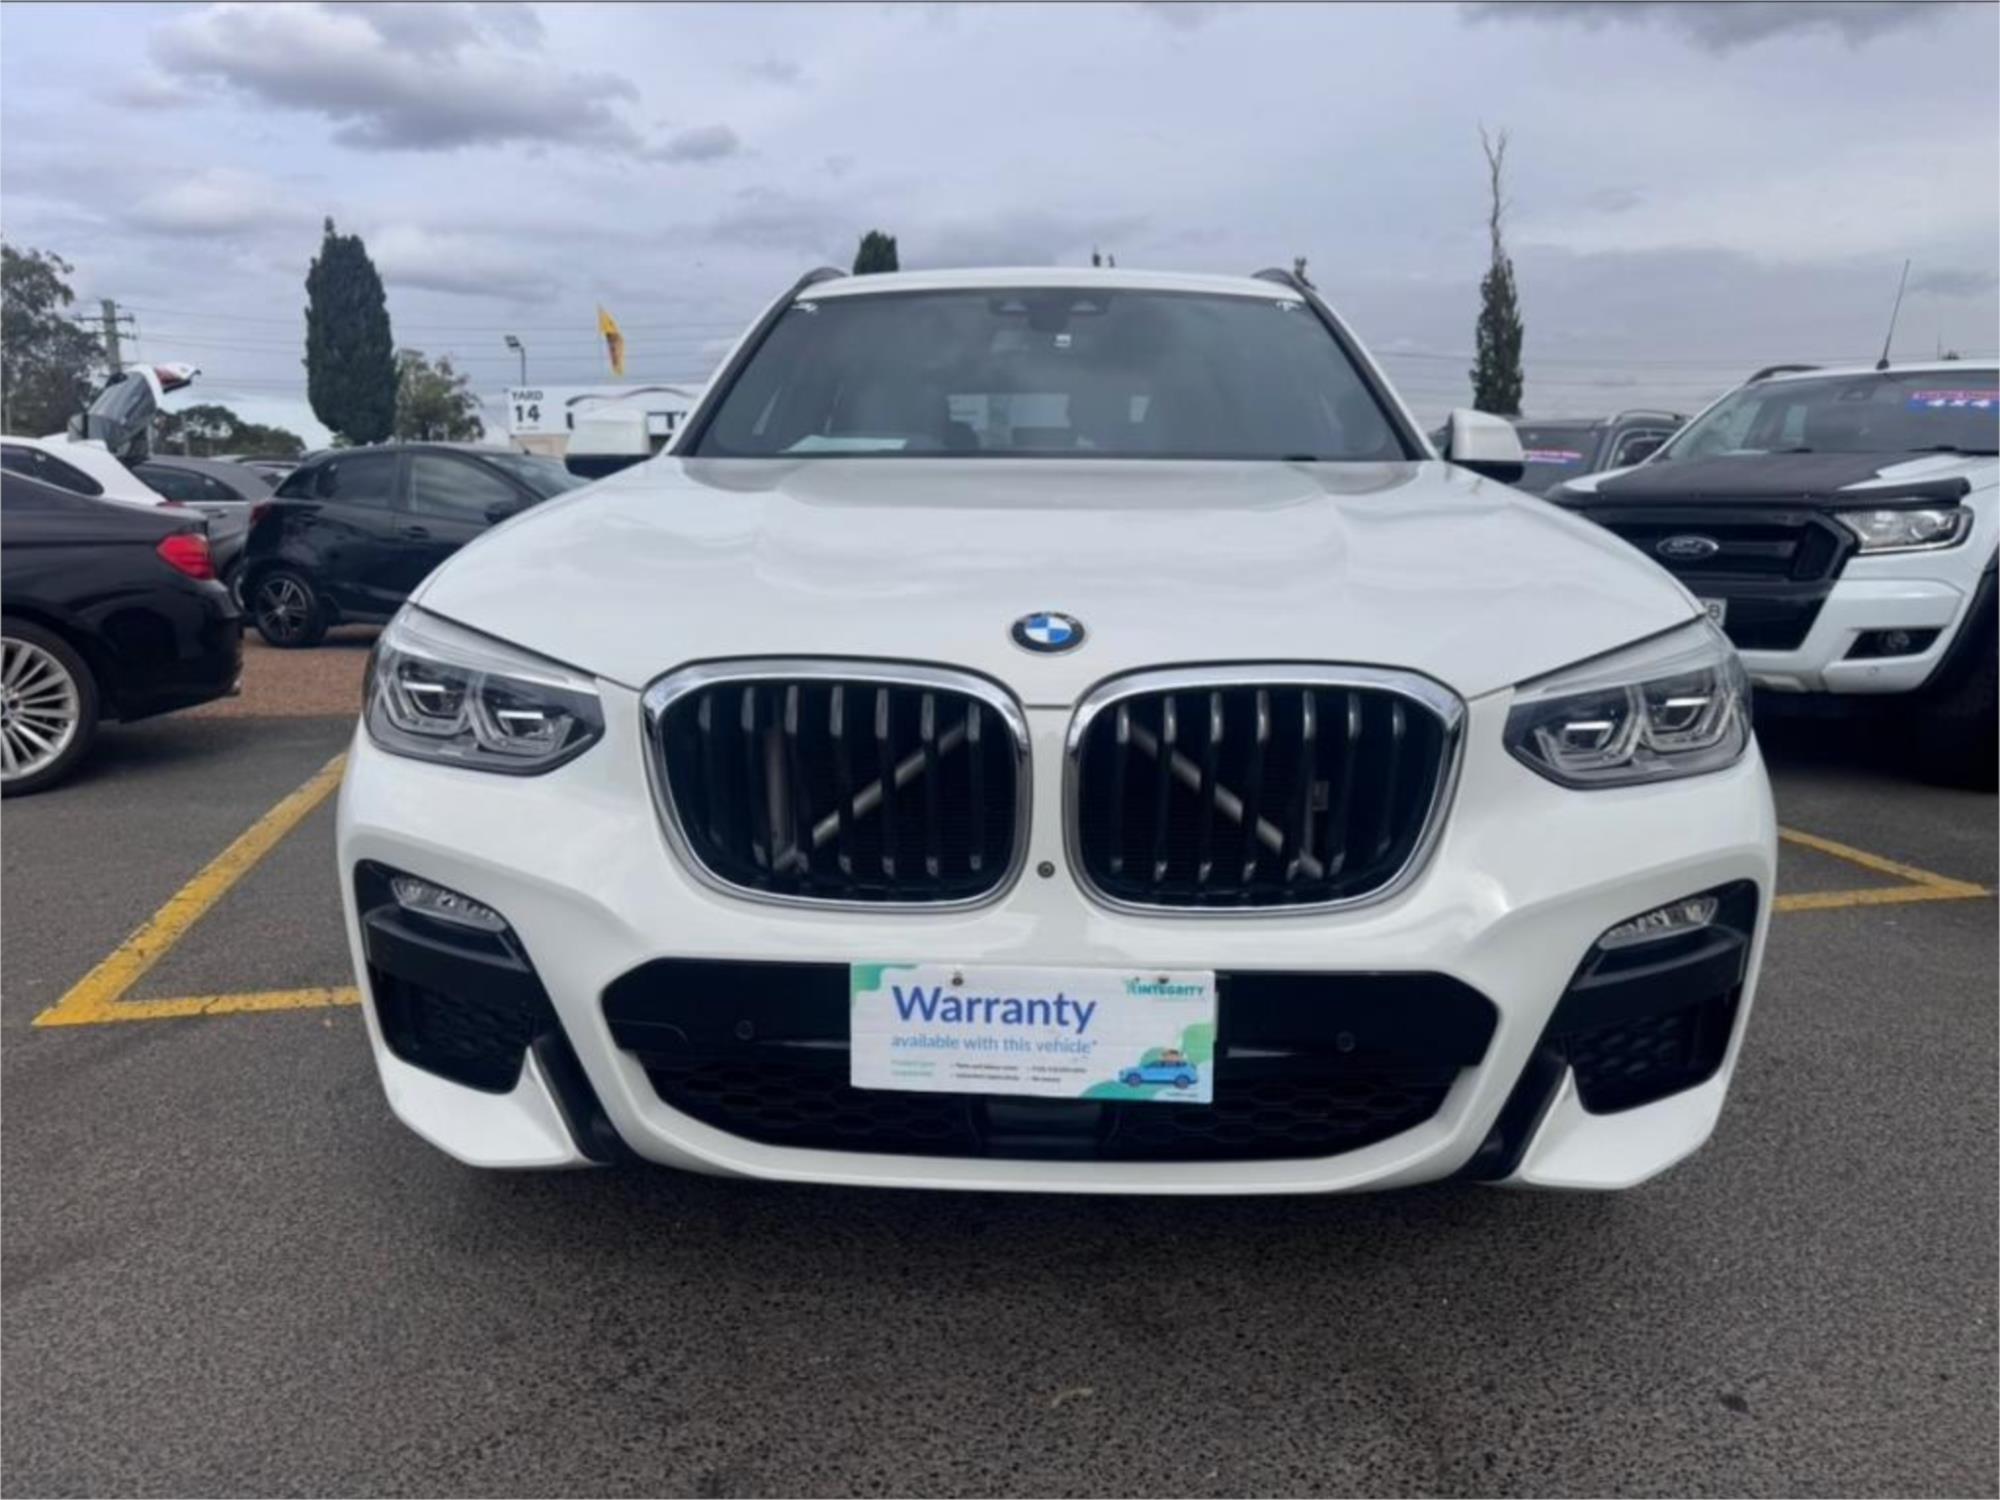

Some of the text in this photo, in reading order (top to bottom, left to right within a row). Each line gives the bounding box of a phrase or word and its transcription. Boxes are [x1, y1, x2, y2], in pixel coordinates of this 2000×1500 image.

[511, 390, 544, 401] YARD
[515, 404, 541, 423] 14
[1135, 983, 1204, 997] INTEGRITY
[892, 985, 1097, 1034] Warranty
[891, 1035, 959, 1050] available
[962, 1036, 999, 1051] with
[1003, 1037, 1033, 1052] this
